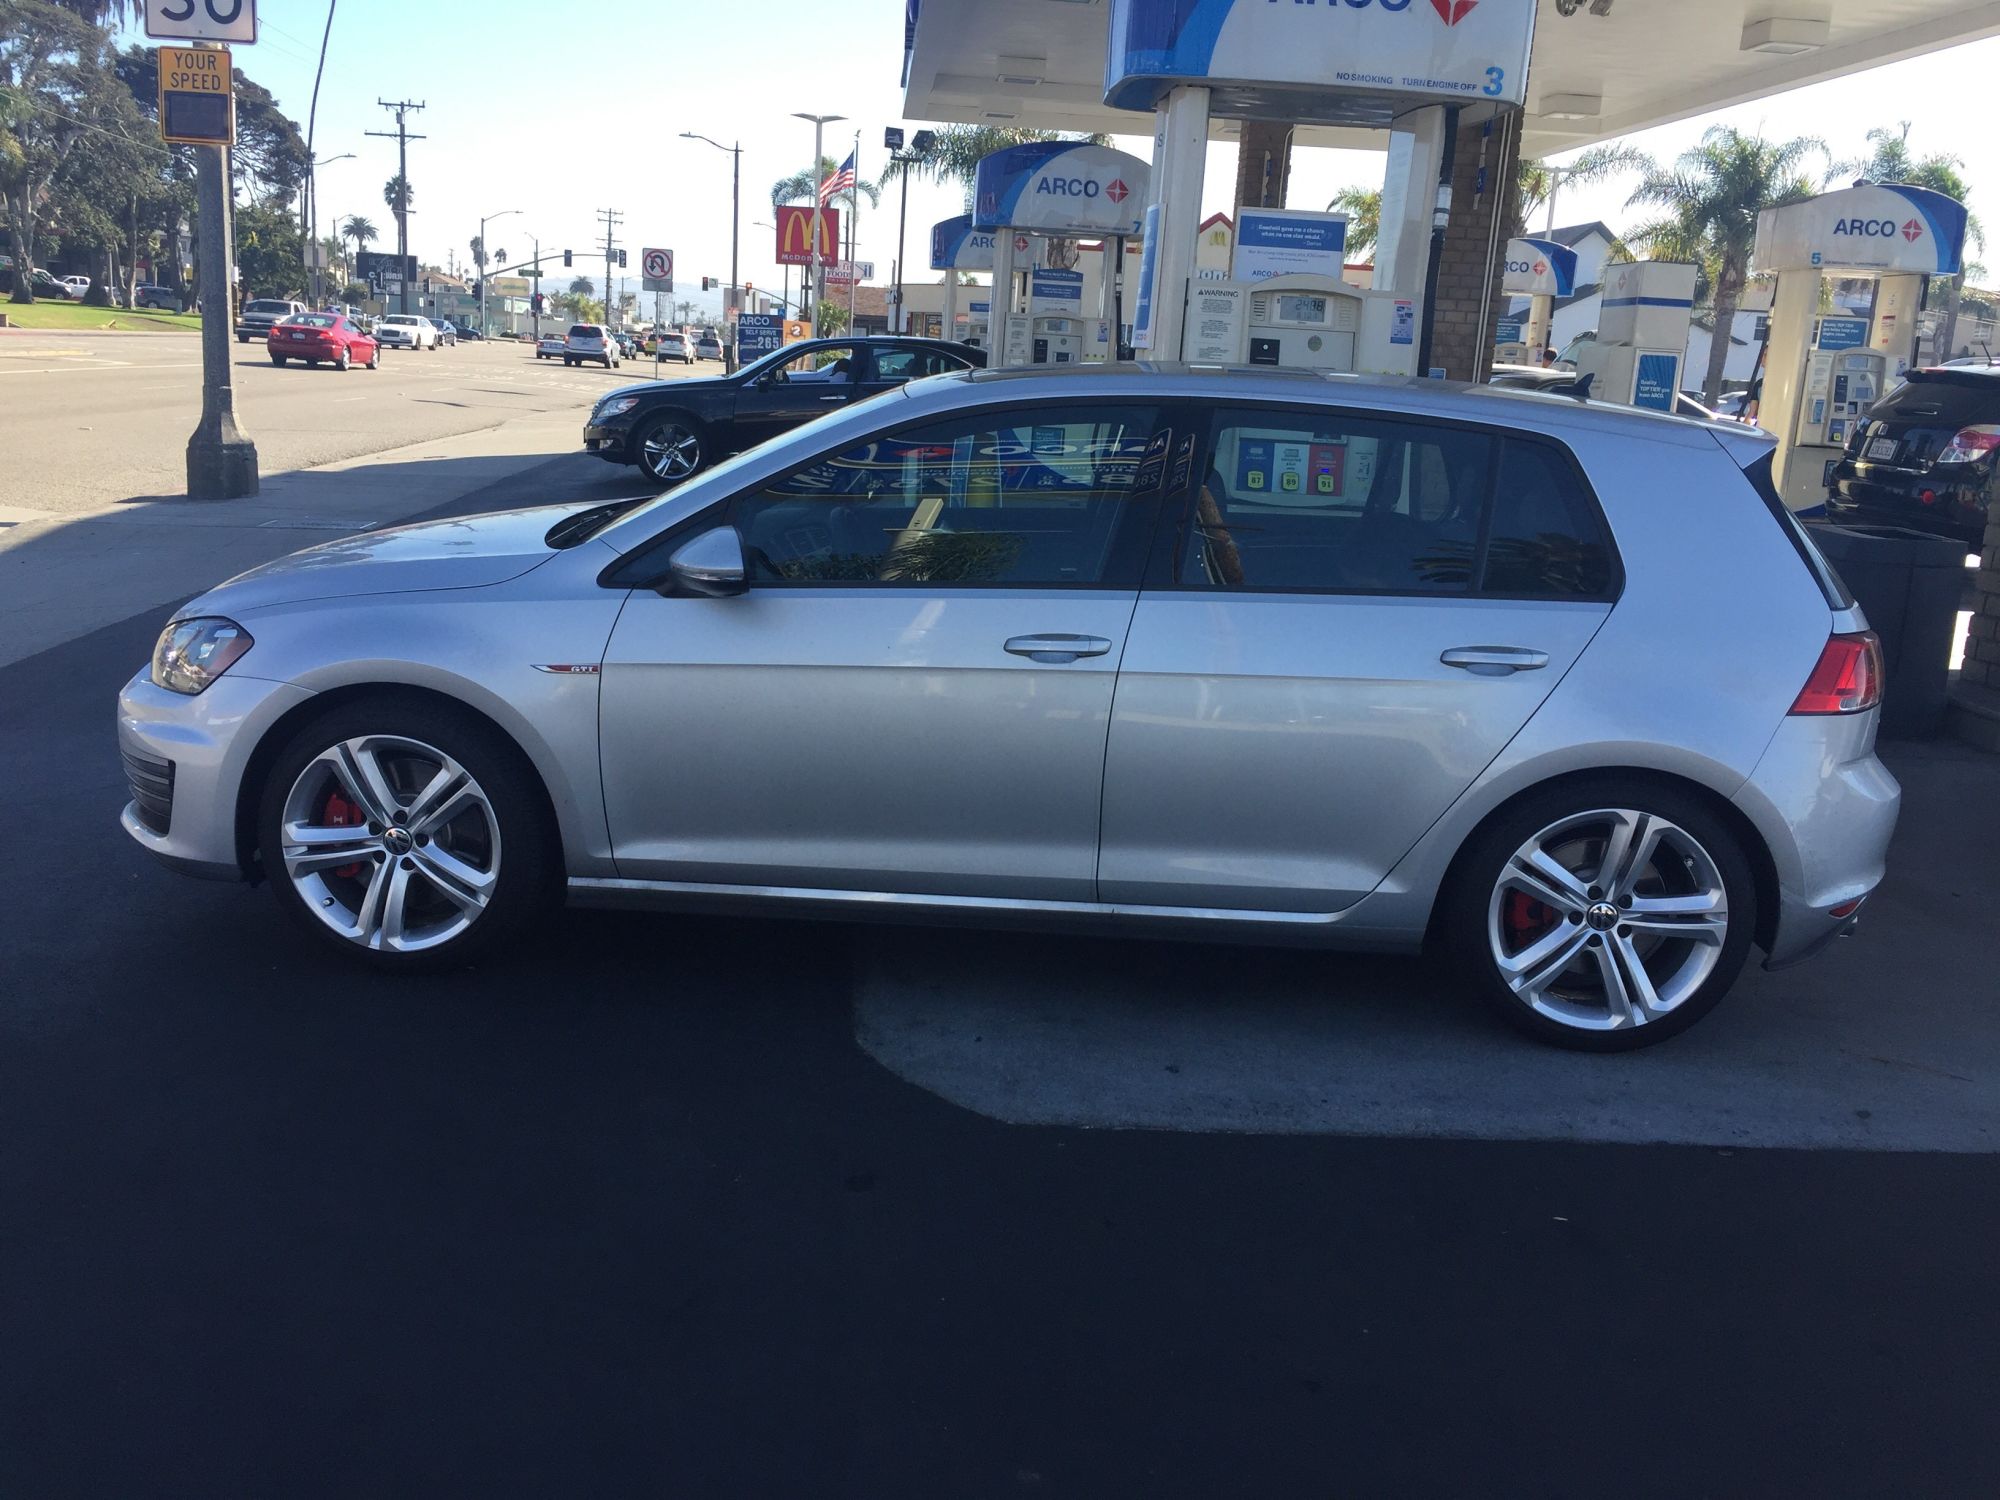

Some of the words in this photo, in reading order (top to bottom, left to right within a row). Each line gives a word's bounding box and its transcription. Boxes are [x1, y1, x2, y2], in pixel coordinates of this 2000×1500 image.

[173, 52, 217, 71] YOUR
[170, 72, 221, 91] SPEED
[1336, 72, 1350, 81] NO
[1351, 74, 1393, 84] SMOKING
[1402, 77, 1425, 87] TURN
[1426, 79, 1459, 90] ENGINE
[1460, 83, 1477, 91] OFF
[1482, 66, 1504, 96] 3
[1036, 176, 1099, 198] ARCO
[1133, 221, 1142, 233] 7
[1833, 218, 1896, 237] ARCO
[970, 236, 996, 248] ARC
[1811, 252, 1821, 265] 5
[1503, 261, 1530, 273] RCO
[1204, 289, 1239, 298] WARNING
[740, 316, 770, 326] ARCO
[1286, 478, 1297, 486] 89
[1321, 480, 1331, 488] 91
